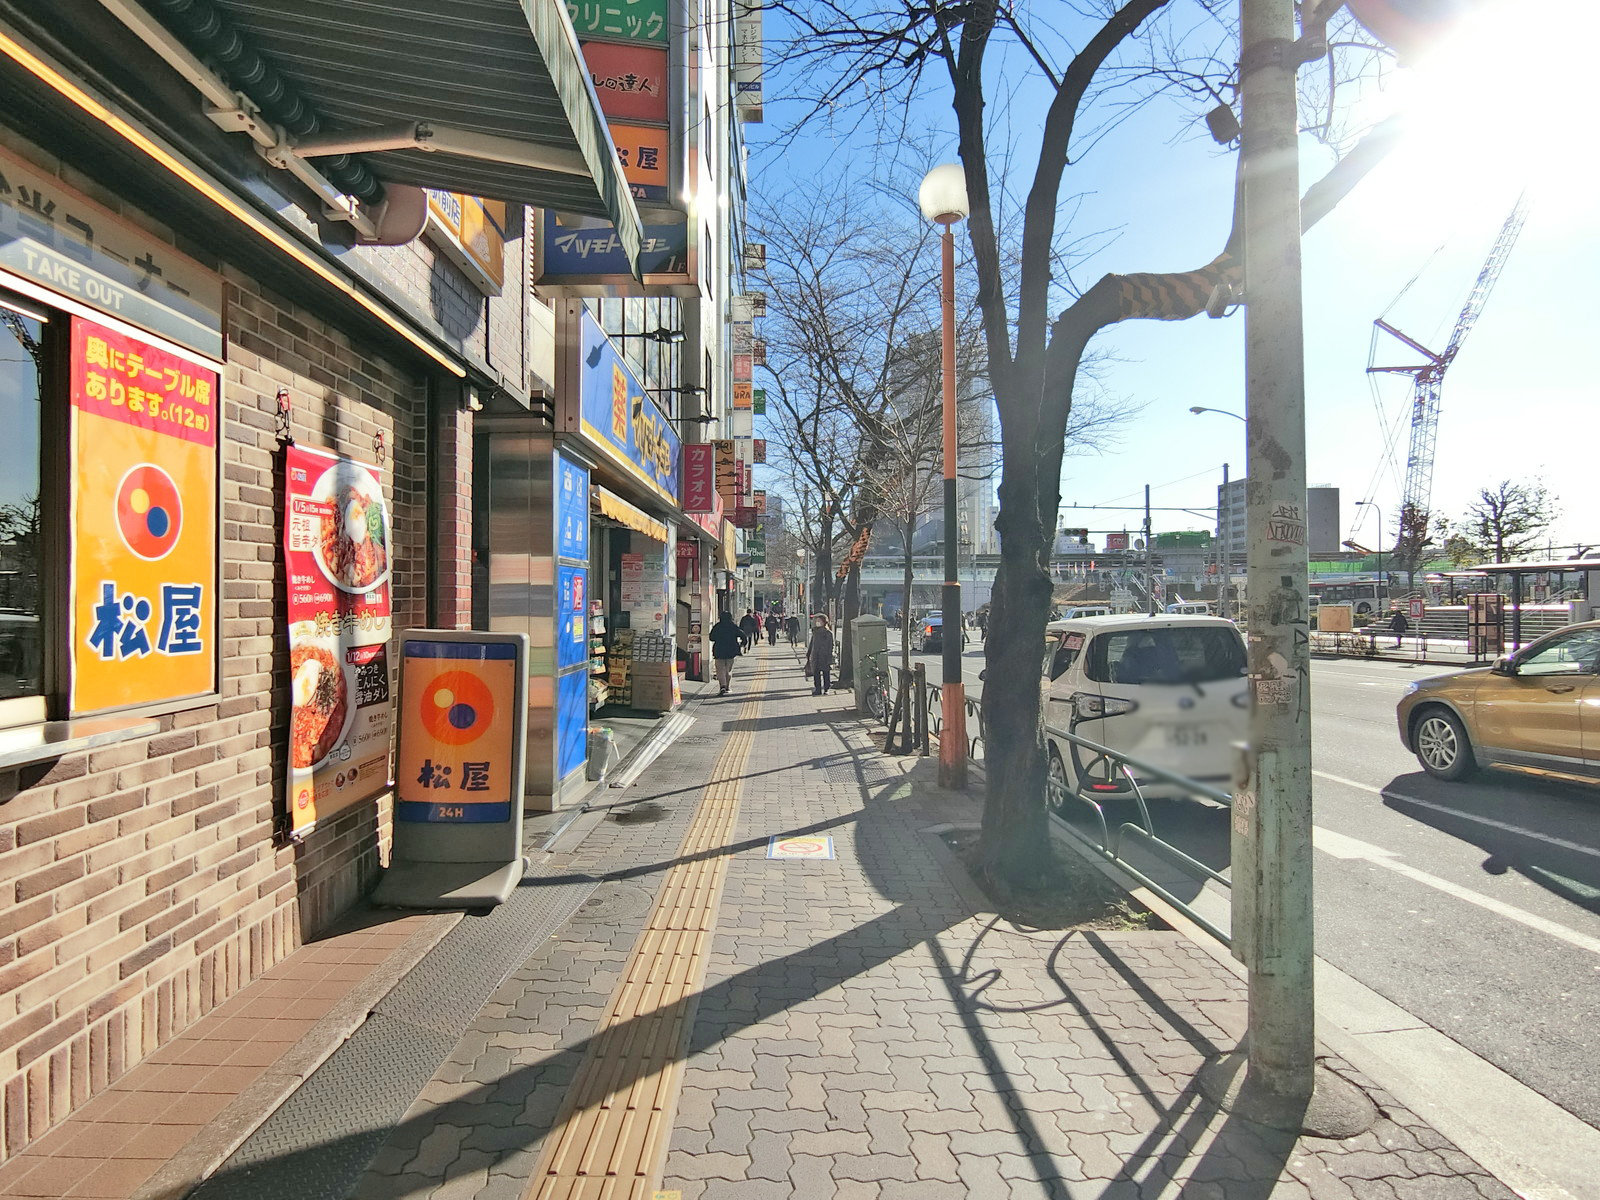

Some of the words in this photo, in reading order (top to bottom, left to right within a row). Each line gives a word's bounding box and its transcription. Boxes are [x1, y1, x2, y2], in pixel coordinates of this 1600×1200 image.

[567, 1, 663, 38] クリニック
[555, 233, 670, 258] マツモトヨシ
[23, 248, 81, 293] TAKE
[85, 278, 124, 310] OUT
[86, 336, 211, 406] 奥にテーブル席
[690, 448, 706, 509] カラオケ
[88, 582, 202, 659] 松屋
[315, 608, 386, 638] 焼き牛めし
[417, 759, 490, 792] 松屋
[439, 807, 464, 818] 24H
